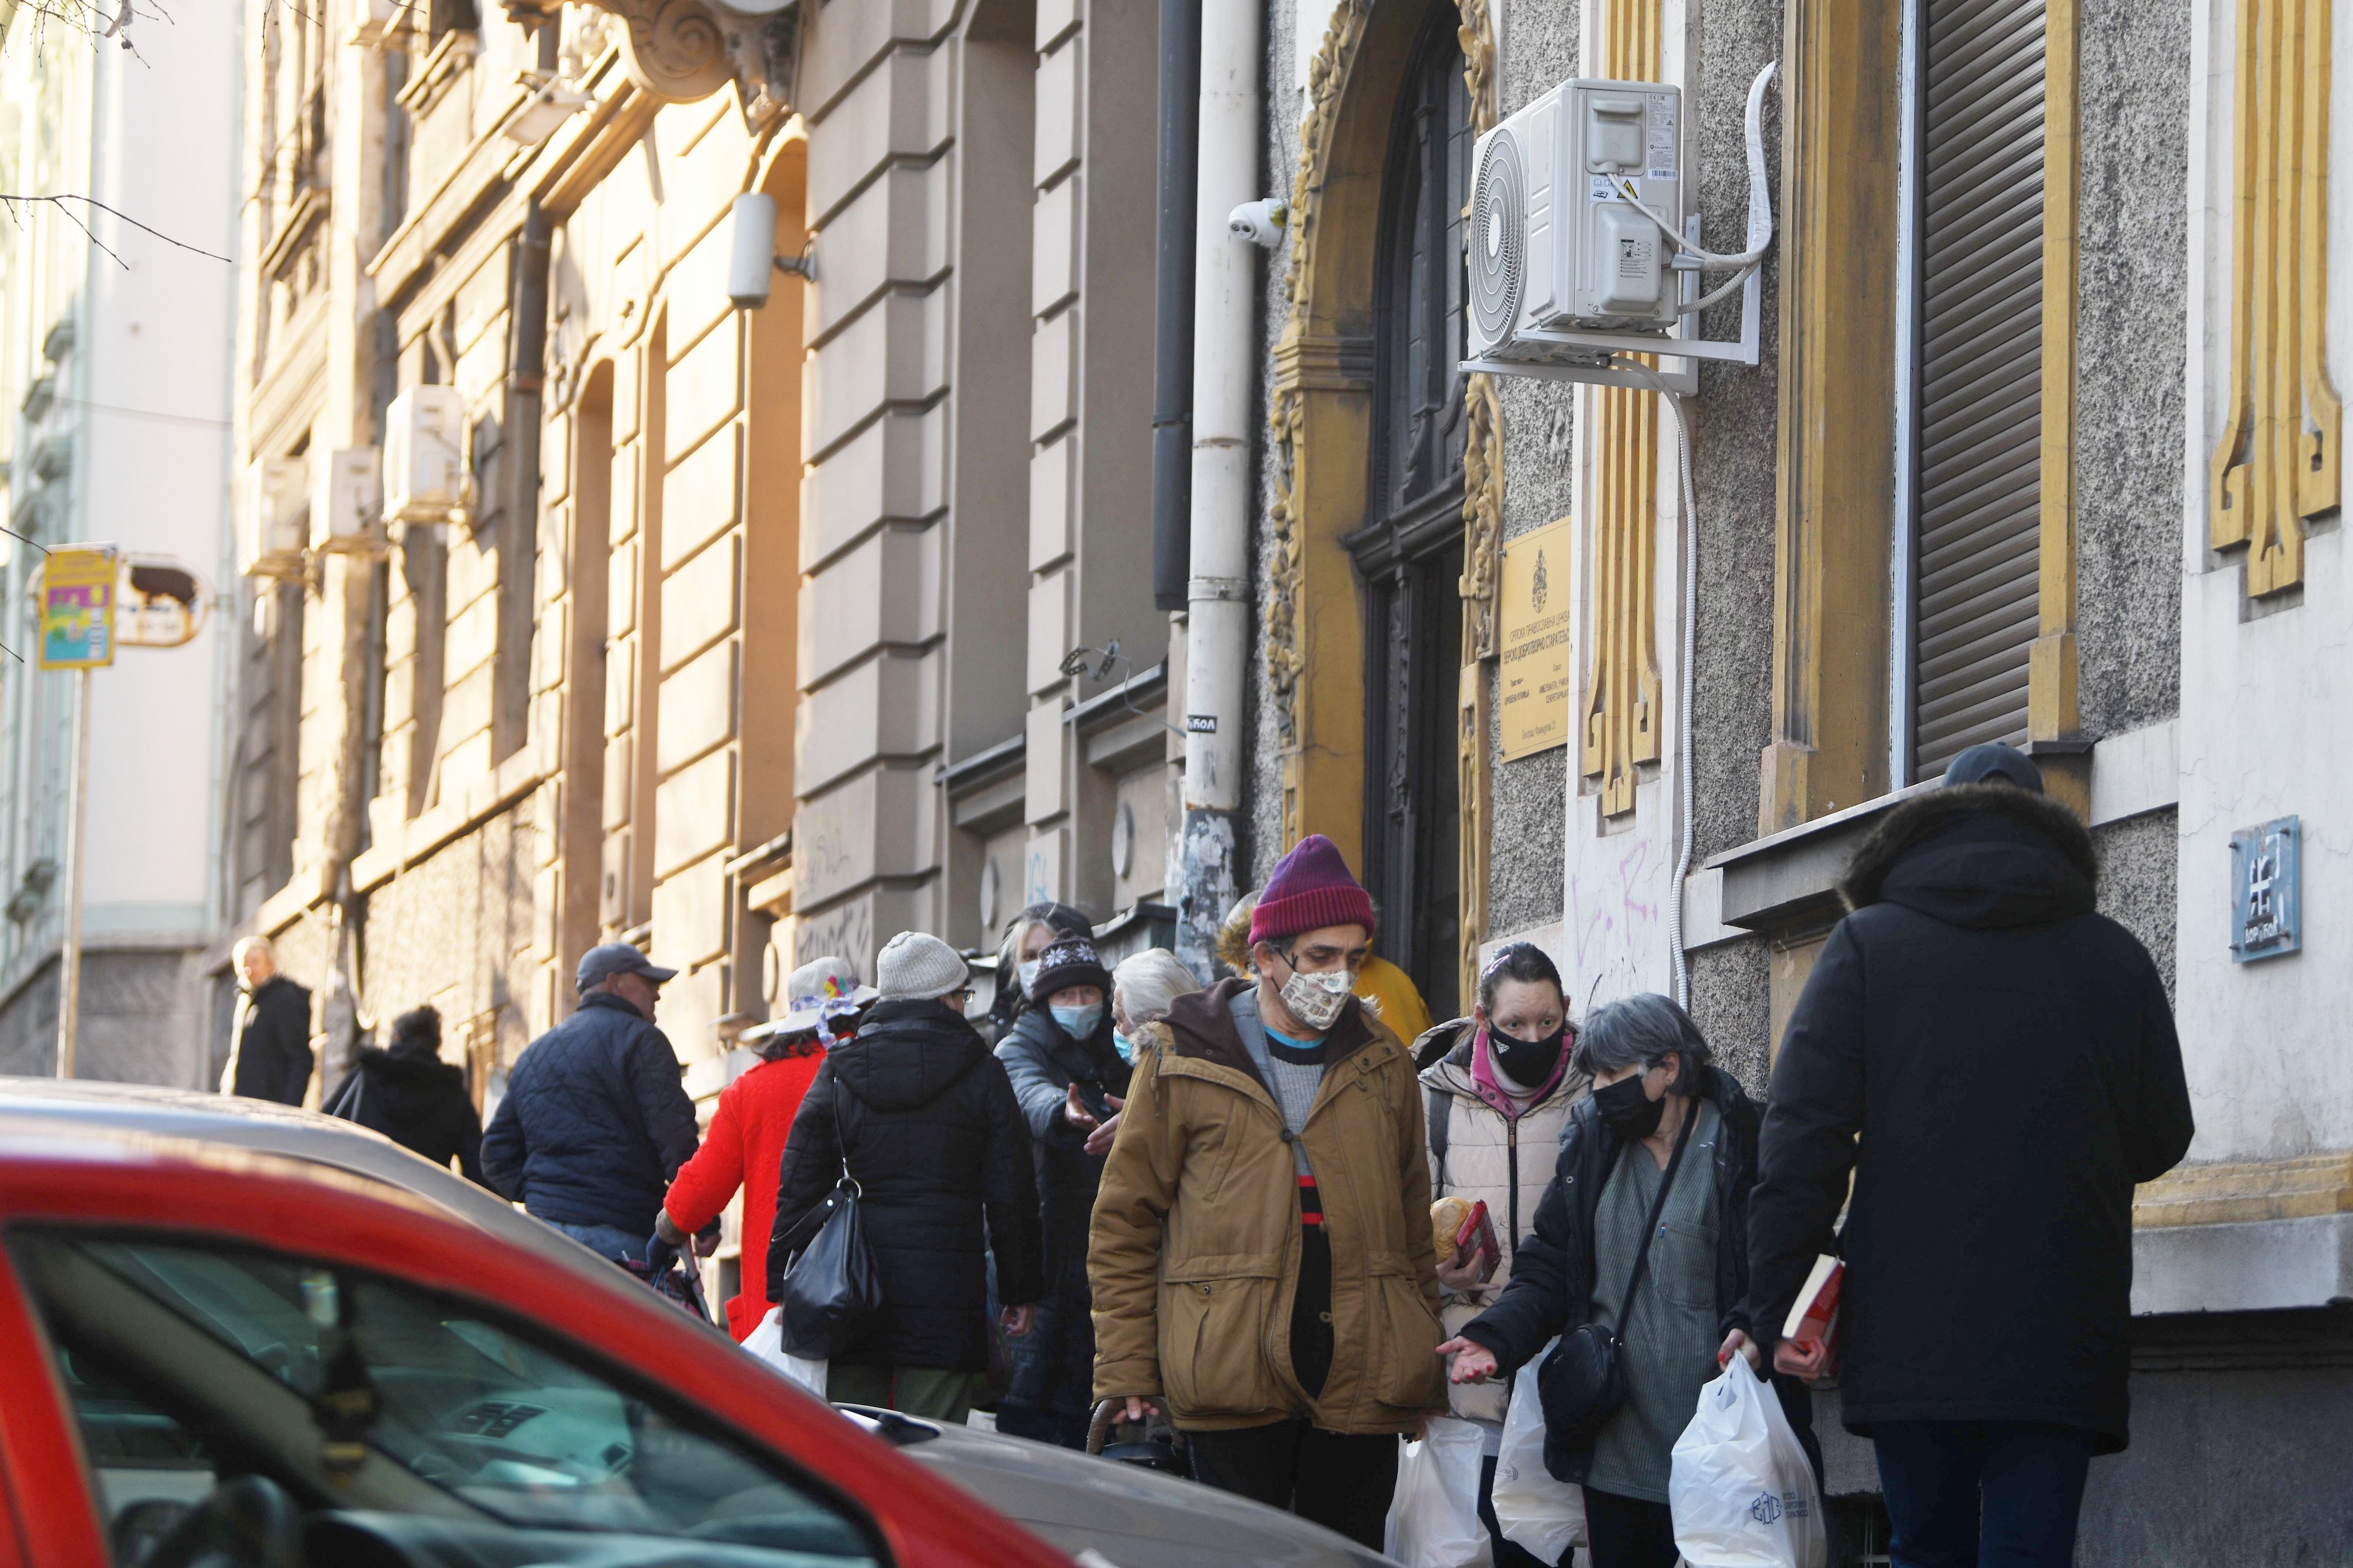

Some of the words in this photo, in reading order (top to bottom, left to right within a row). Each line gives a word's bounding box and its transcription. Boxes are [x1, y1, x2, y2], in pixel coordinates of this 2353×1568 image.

[1509, 626, 1525, 642] СРПСКА
[1526, 615, 1555, 636] ПРАВОСЛАВНА
[1556, 610, 1570, 626] ЦРКВА
[1504, 647, 1518, 665] ВЕРСКО
[1518, 637, 1545, 662] ДОБРОТВОРНО
